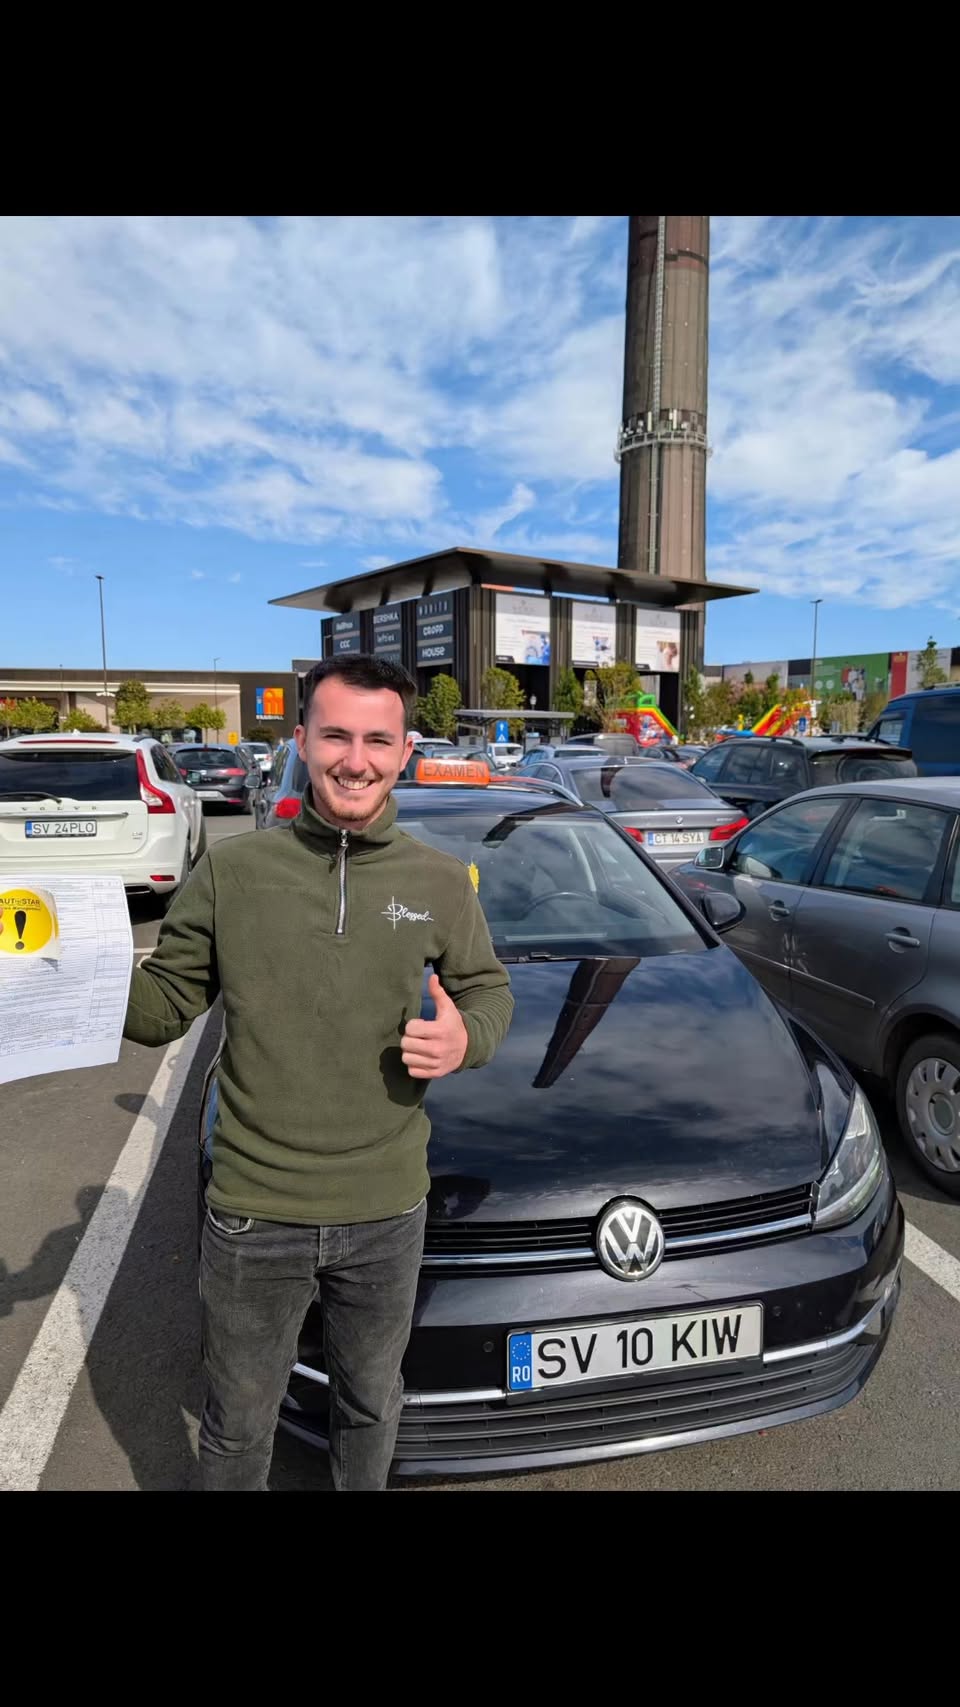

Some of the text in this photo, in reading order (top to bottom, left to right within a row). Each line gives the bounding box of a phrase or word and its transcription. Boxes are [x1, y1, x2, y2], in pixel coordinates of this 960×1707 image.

[423, 624, 444, 636] CROPP
[340, 640, 351, 649] CCC
[422, 647, 445, 658] HOUSE
[423, 762, 485, 778] EXAMEN
[33, 824, 50, 834] SV
[655, 833, 667, 844] CT
[381, 895, 434, 930] Blessed
[537, 1313, 743, 1380] SV 10 KIW
[512, 1365, 531, 1383] RO
